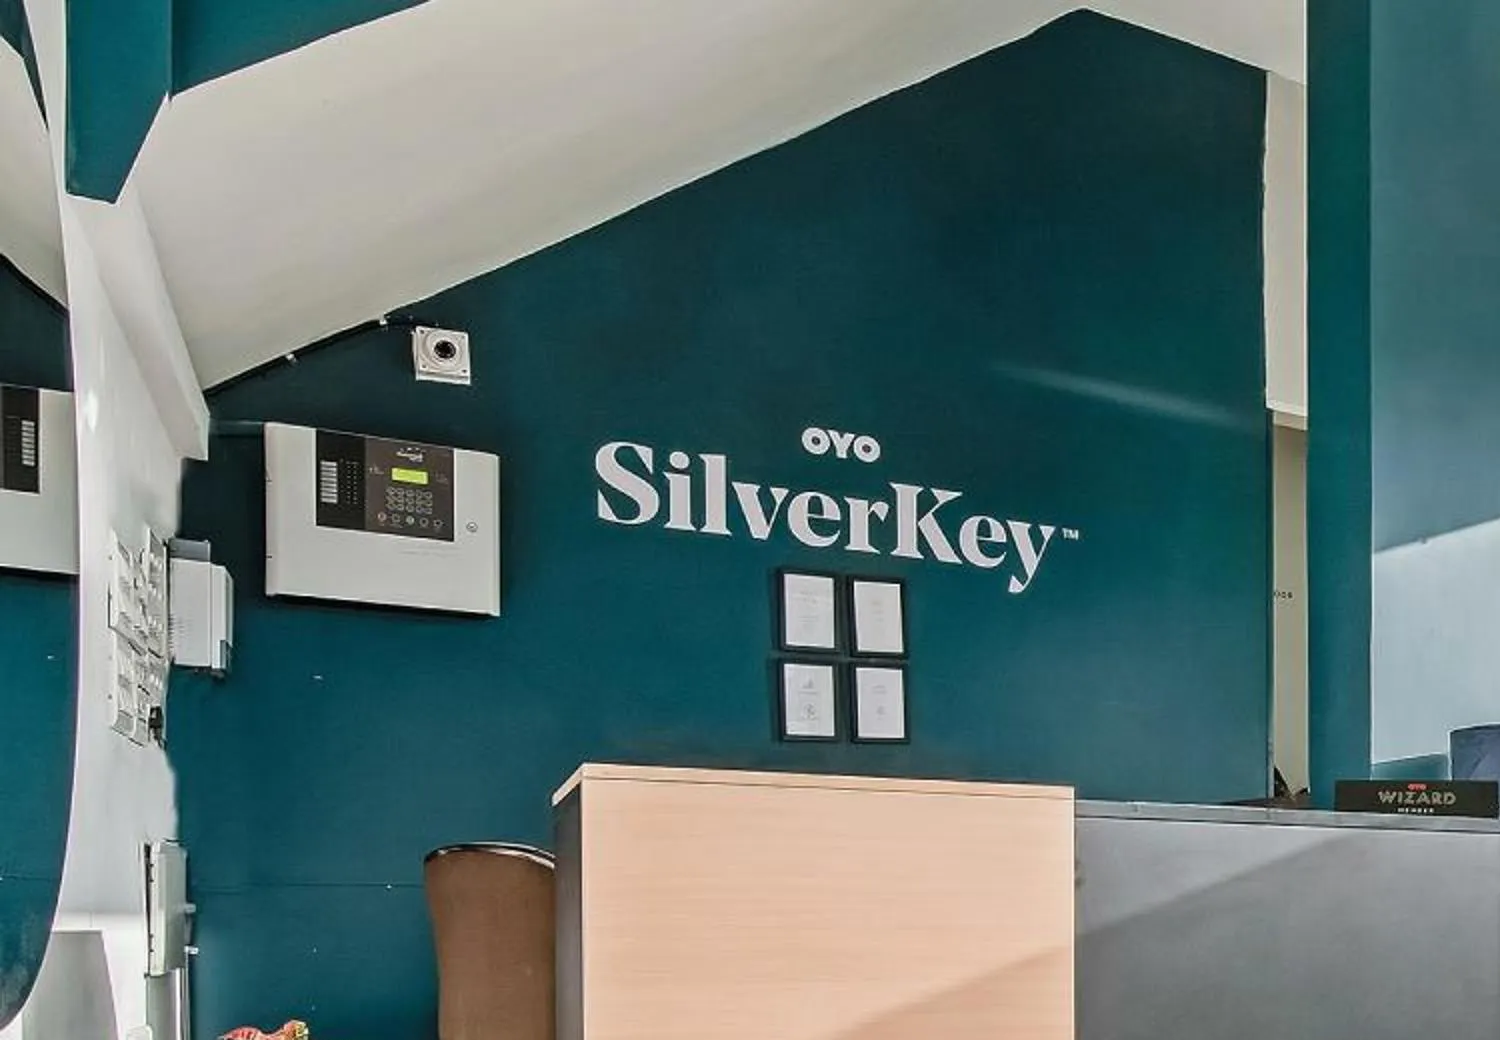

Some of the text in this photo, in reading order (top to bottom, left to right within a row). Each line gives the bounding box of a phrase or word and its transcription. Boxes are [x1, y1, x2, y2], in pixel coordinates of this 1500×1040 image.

[801, 427, 881, 463] OYO
[595, 441, 1056, 594] SilverKey
[1377, 790, 1457, 805] WIZARD
